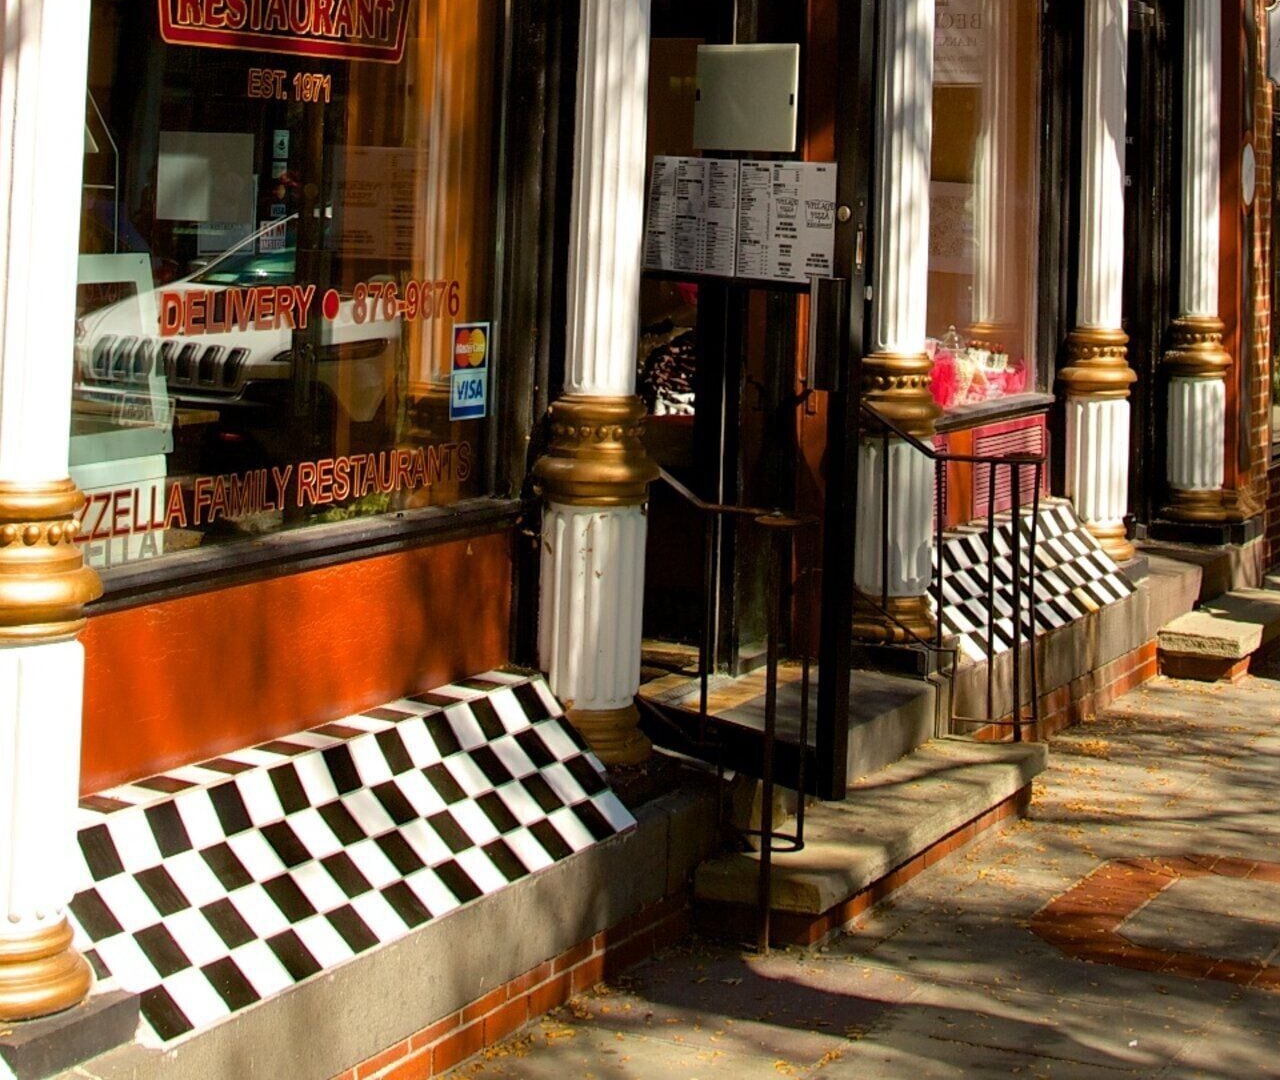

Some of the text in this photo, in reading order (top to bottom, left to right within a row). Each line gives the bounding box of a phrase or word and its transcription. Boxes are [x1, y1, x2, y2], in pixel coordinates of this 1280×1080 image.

[248, 68, 332, 103] EST. 1971
[159, 280, 461, 337] DELIVERY 876-9676
[457, 379, 483, 400] VISA
[193, 464, 292, 526] FAMILY
[297, 439, 472, 507] RESTAURANTS
